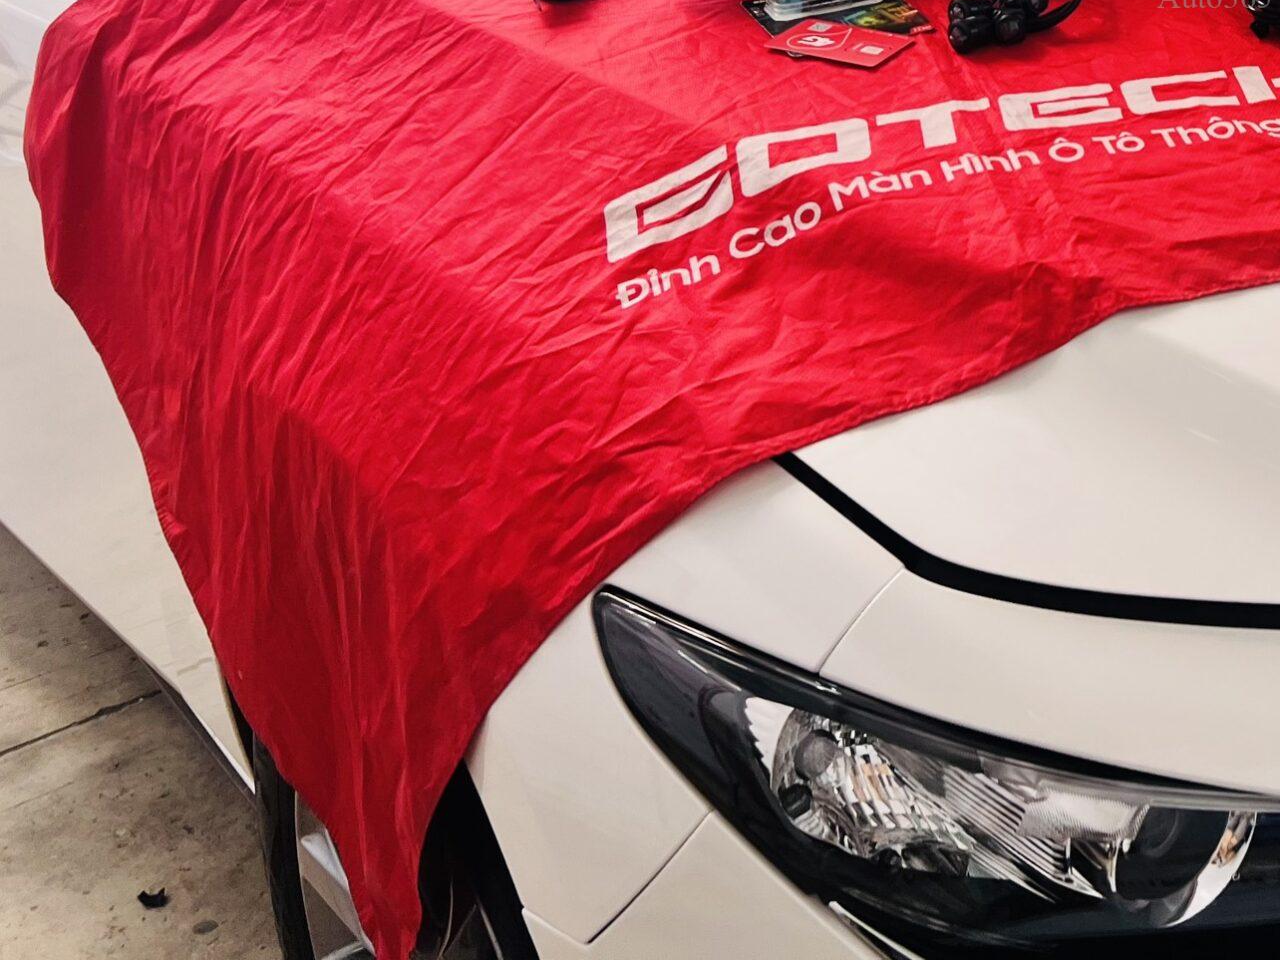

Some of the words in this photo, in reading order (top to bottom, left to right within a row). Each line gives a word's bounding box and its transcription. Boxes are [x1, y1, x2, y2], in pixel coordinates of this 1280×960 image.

[729, 201, 821, 259] Cao
[827, 167, 933, 212] Màn
[940, 146, 1041, 184] Hình
[1048, 138, 1085, 163] Ô
[1092, 131, 1146, 155] Tô
